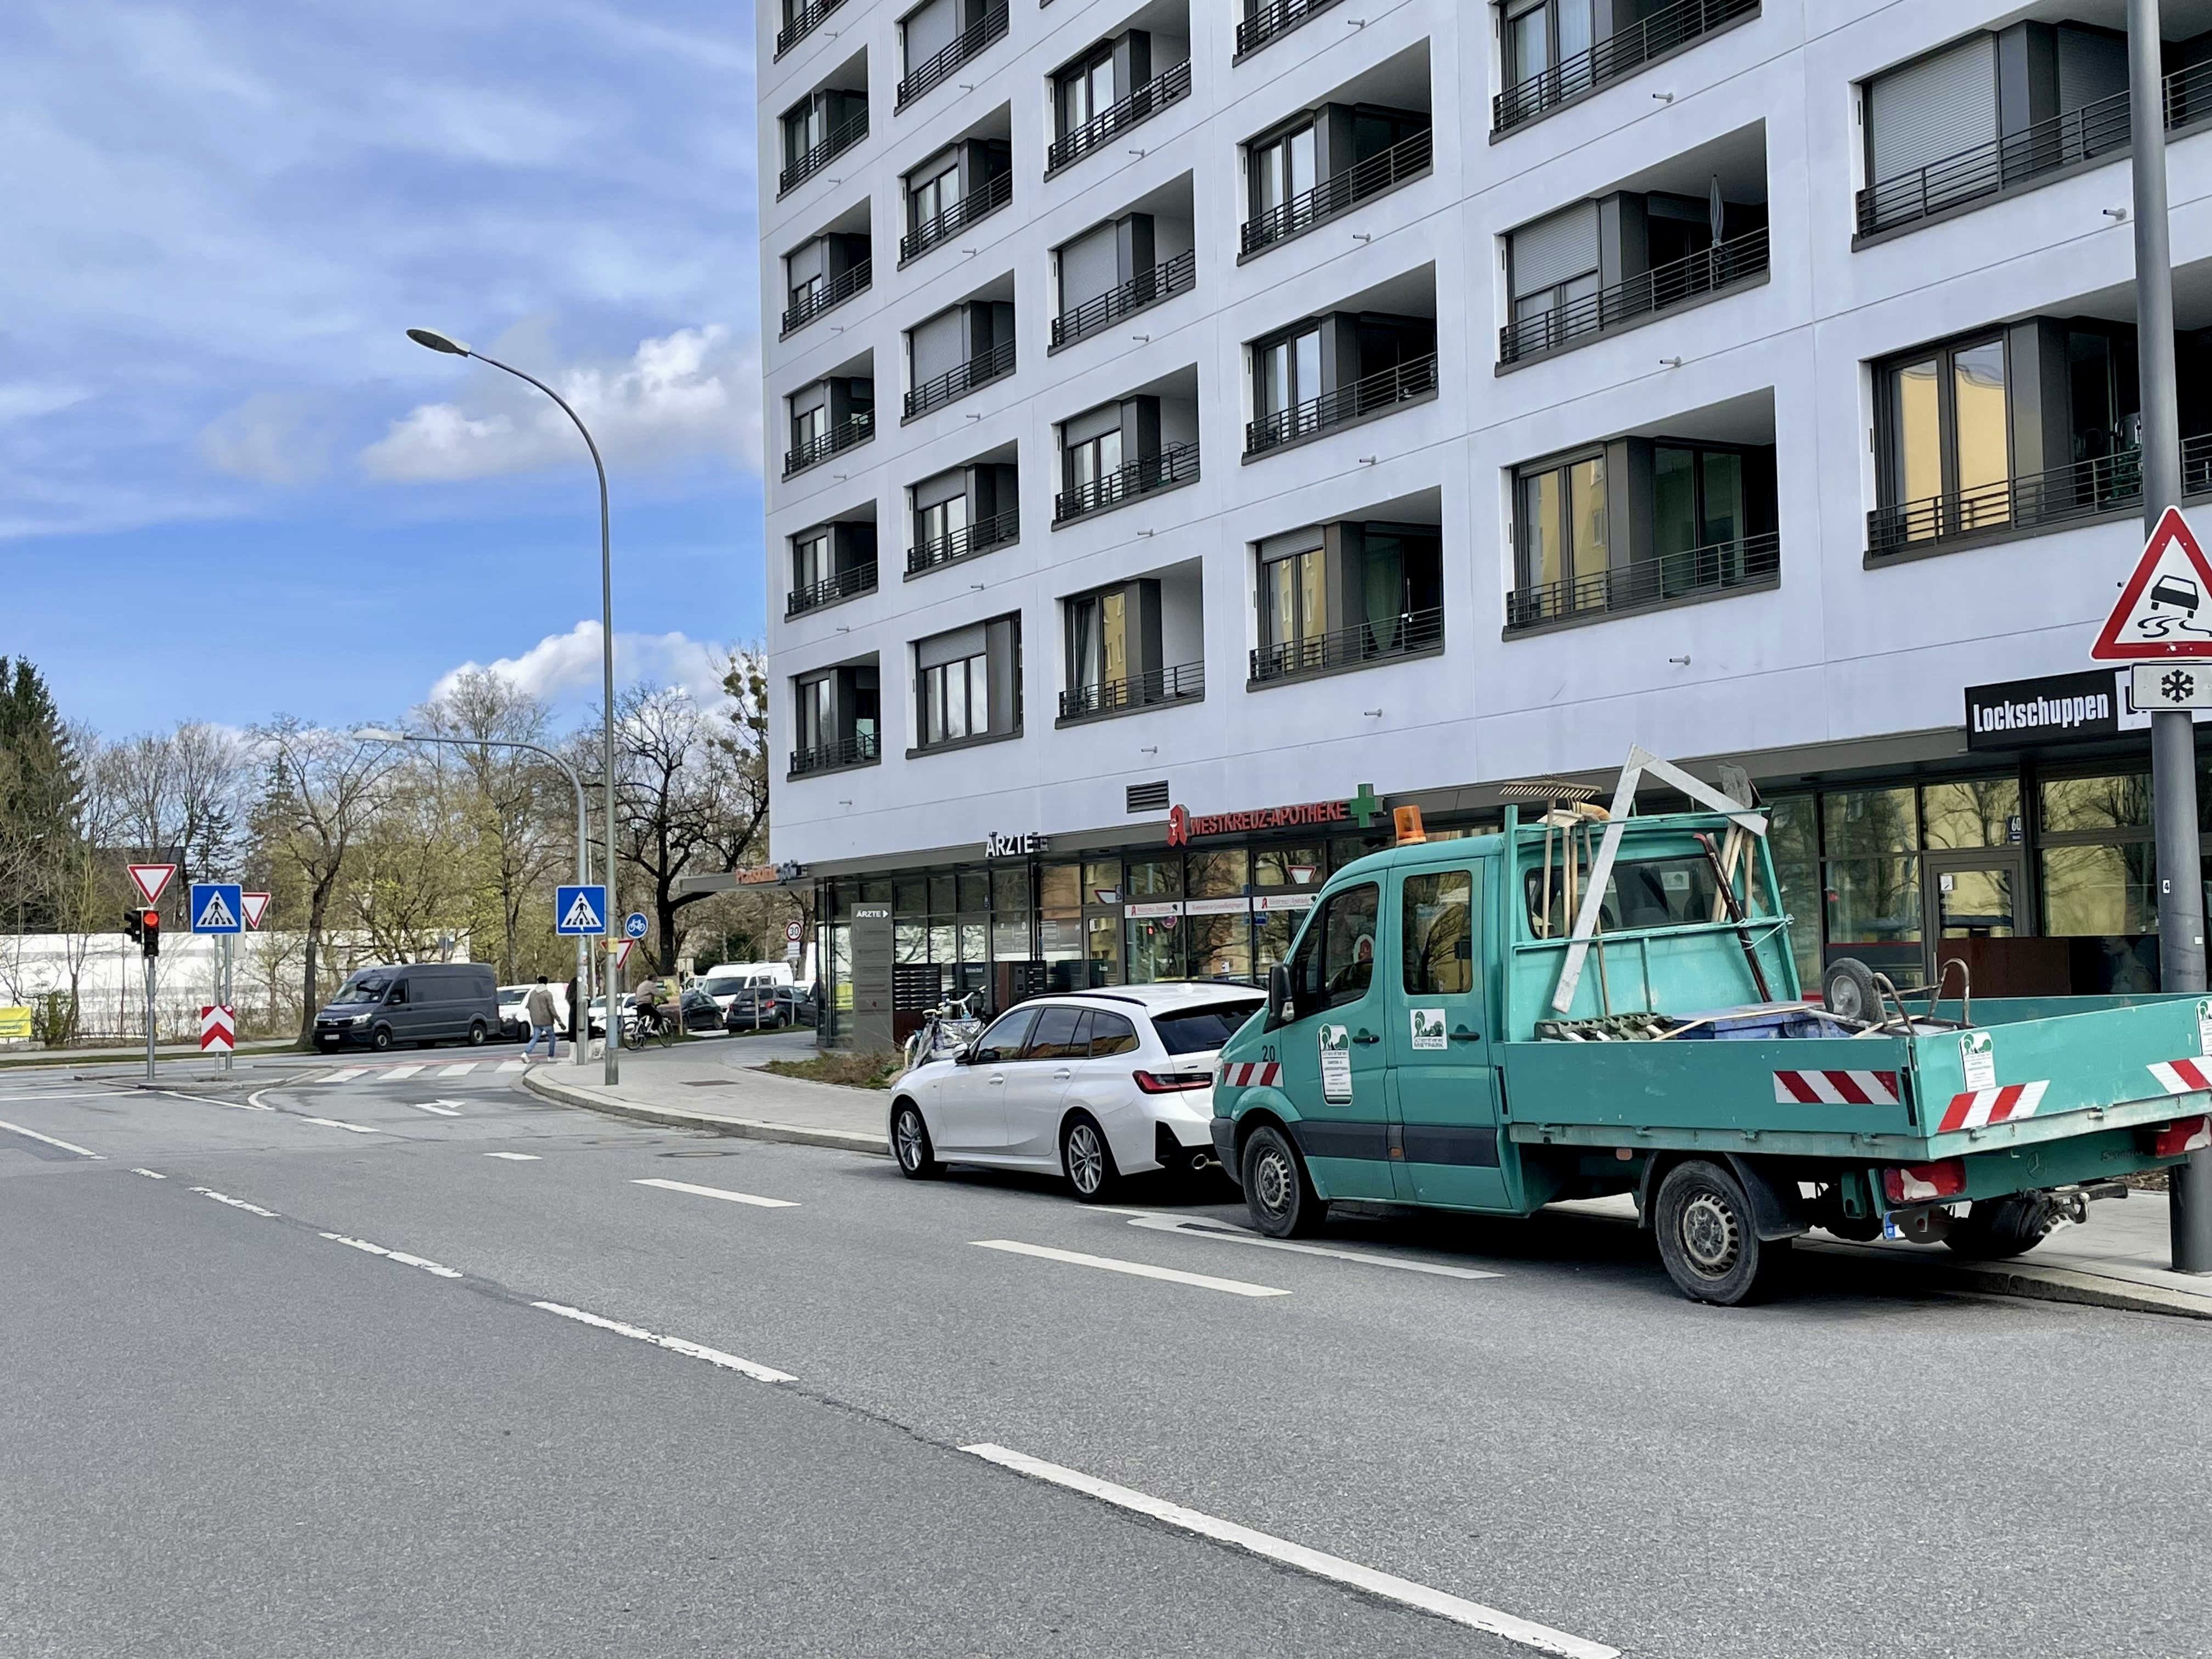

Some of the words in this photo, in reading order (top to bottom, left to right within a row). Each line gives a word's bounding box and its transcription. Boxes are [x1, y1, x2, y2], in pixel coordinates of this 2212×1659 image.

[1973, 693, 2108, 732] Lockschuppen
[1190, 800, 1347, 835] WESTKREUZ-APOTHEKE
[2011, 817, 2022, 831] 60
[985, 830, 1034, 857] ÄRZTE
[2164, 882, 2169, 891] 4
[789, 927, 799, 936] 30
[1262, 1045, 1276, 1062] 20
